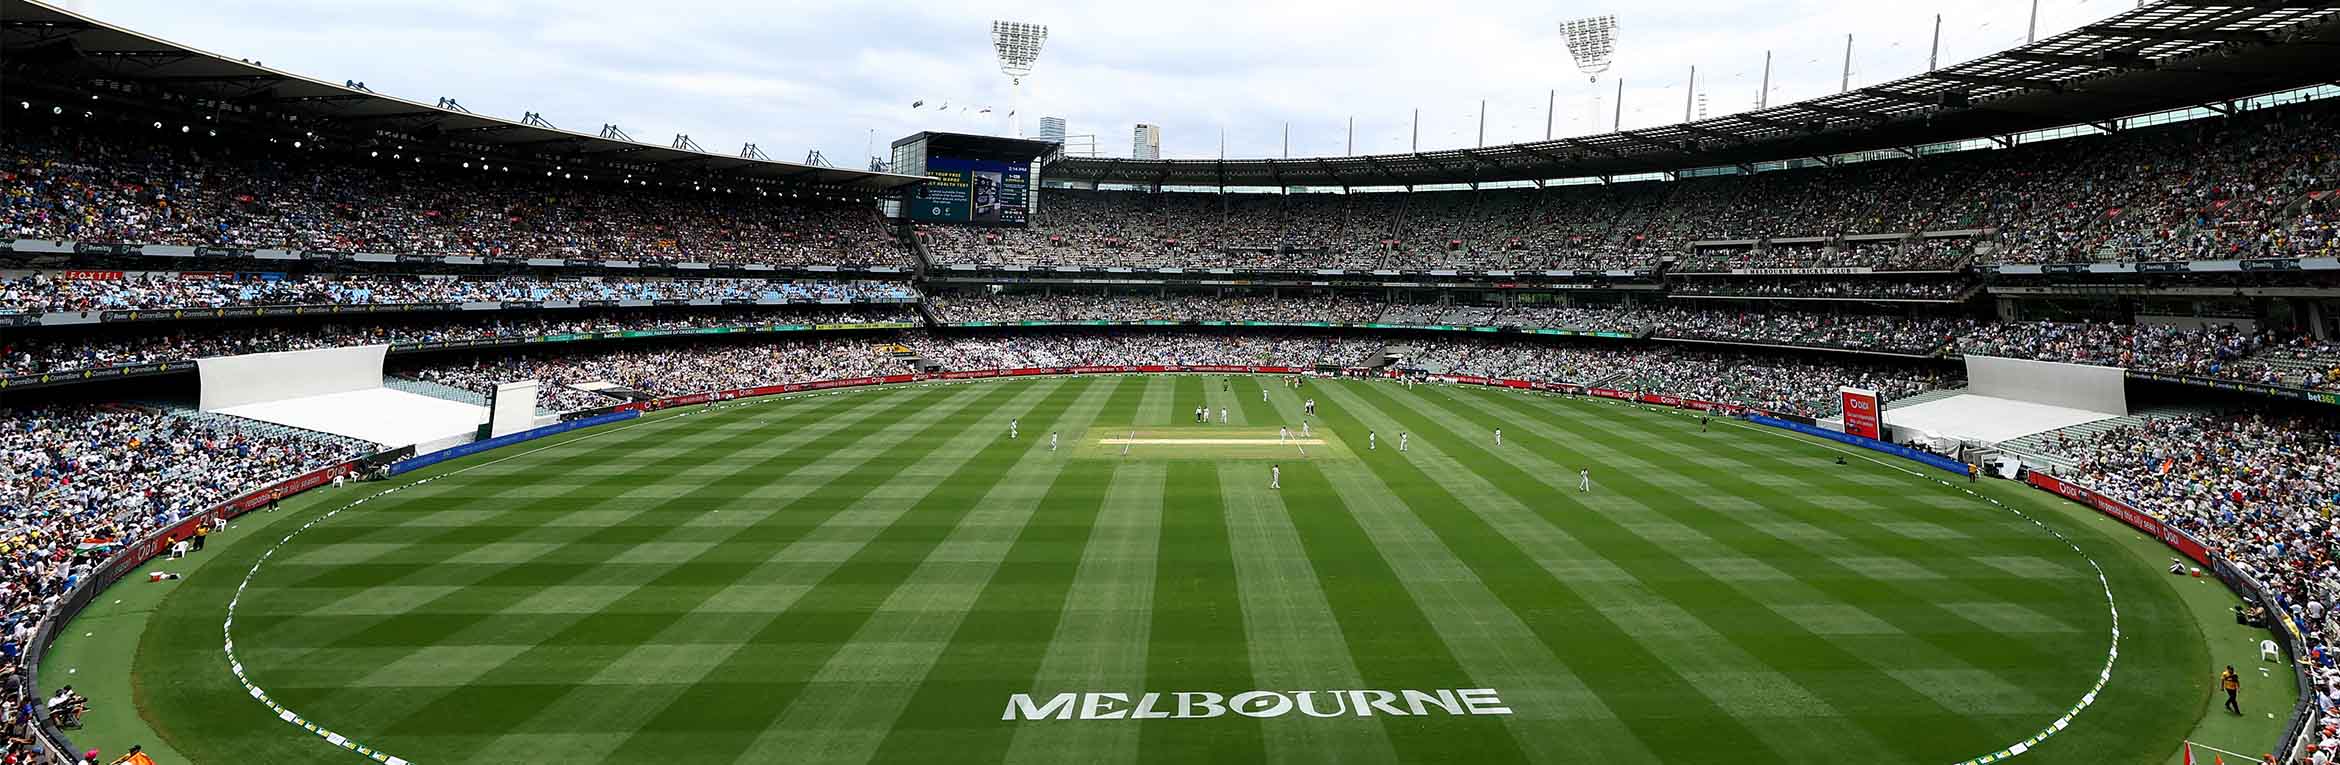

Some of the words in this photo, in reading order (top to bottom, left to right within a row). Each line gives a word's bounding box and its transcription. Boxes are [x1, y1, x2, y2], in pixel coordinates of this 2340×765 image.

[70, 271, 118, 279] FOXTEL
[2307, 392, 2336, 404] bet365
[1001, 688, 1514, 721] MELBOURNE
